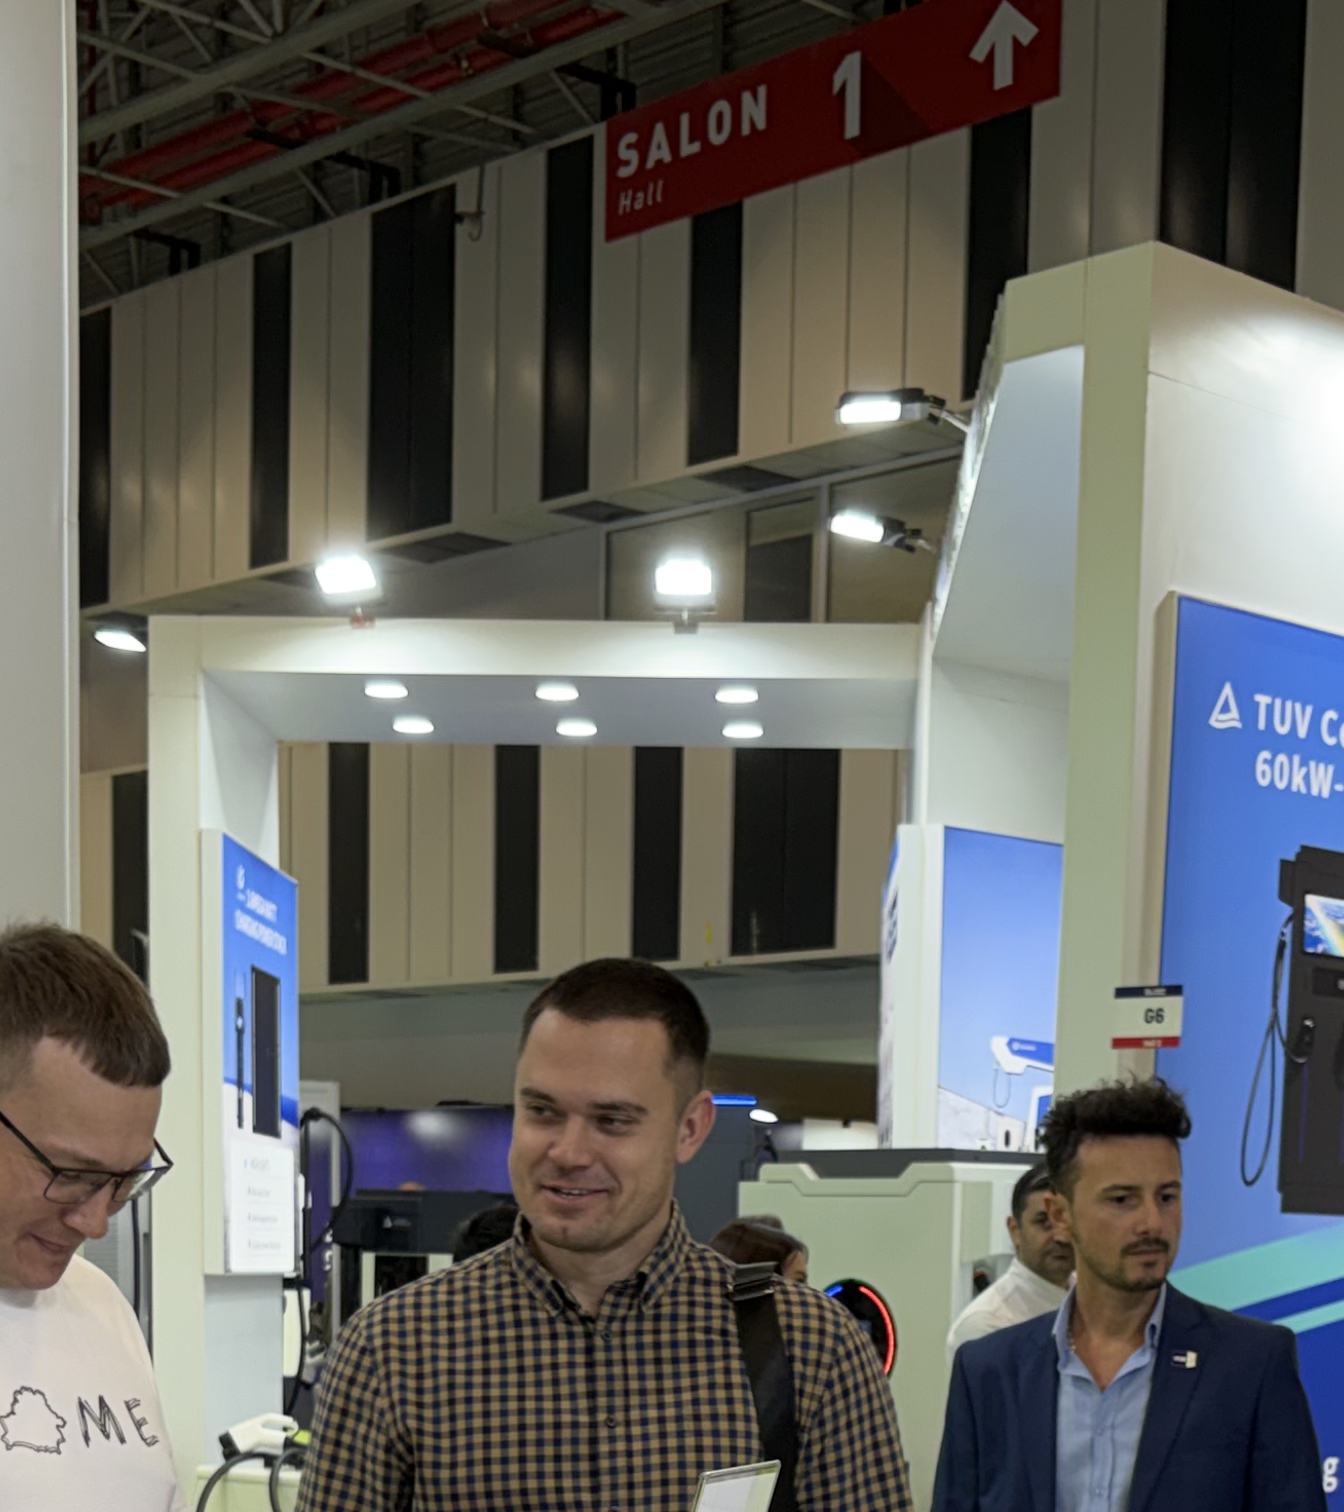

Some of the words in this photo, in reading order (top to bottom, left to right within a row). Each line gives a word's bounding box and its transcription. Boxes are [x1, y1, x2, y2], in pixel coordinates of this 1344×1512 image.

[616, 84, 767, 178] SALON
[832, 50, 862, 141] 1
[618, 180, 664, 216] Hall
[1253, 693, 1313, 739] TUV
[1144, 1007, 1165, 1024] G6
